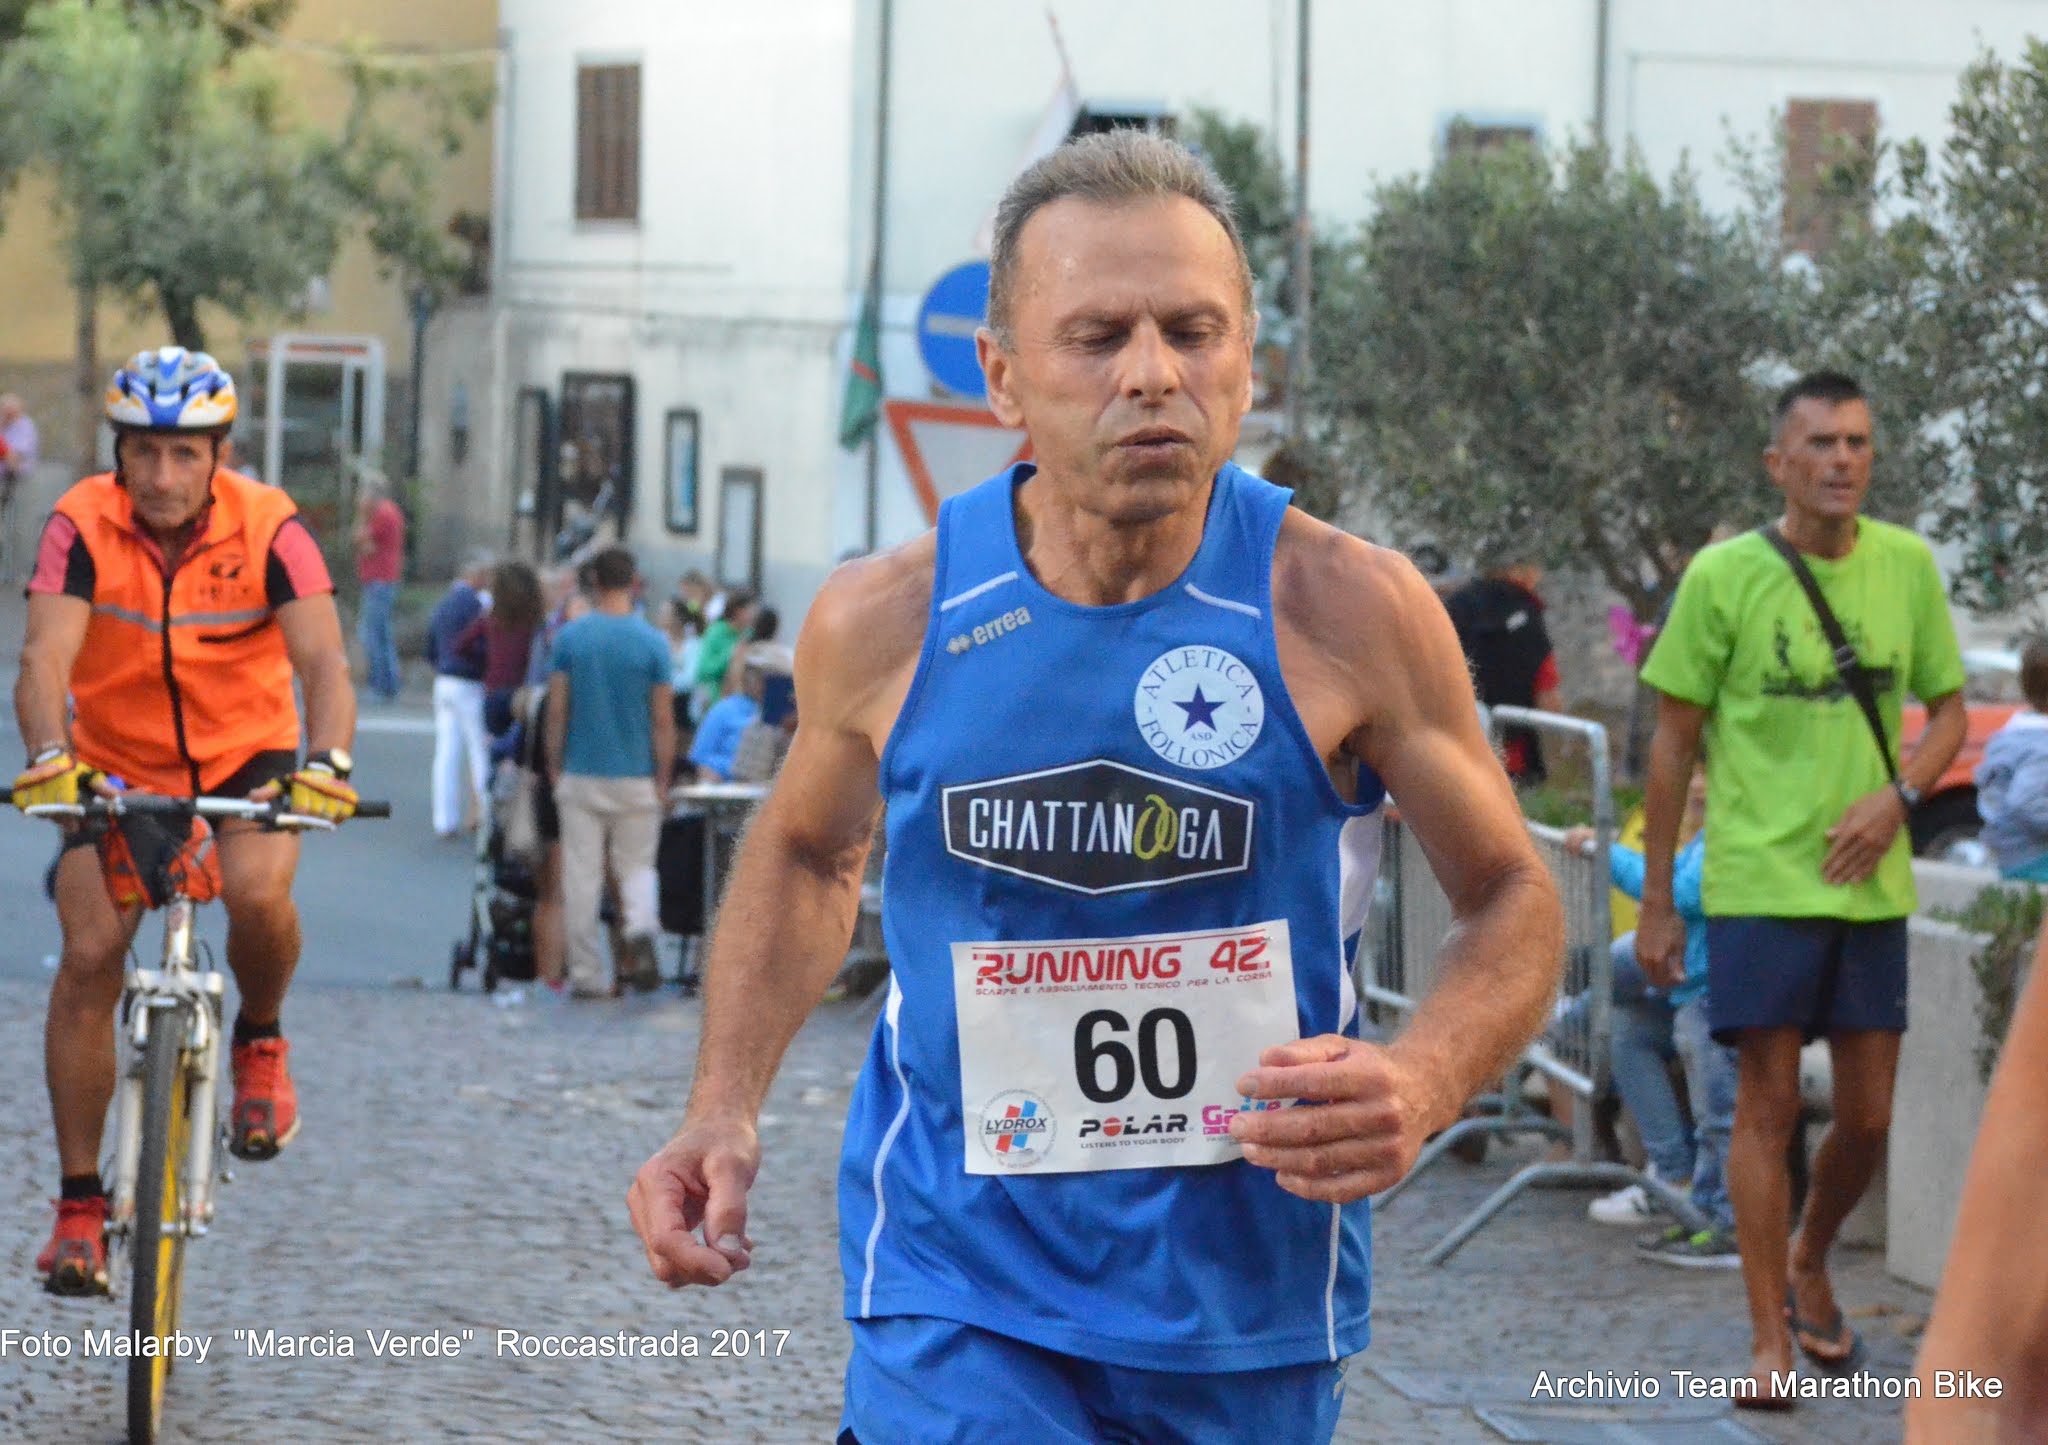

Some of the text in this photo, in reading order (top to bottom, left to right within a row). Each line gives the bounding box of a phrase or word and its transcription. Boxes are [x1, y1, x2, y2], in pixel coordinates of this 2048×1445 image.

[973, 606, 1031, 645] errea
[1143, 649, 1255, 699] ATLETICA
[1141, 720, 1258, 767] FOLLONICA
[1191, 732, 1212, 741] ASD
[968, 794, 1223, 860] CHATTANOOGA
[973, 936, 1270, 986] RUNNING 42
[1134, 980, 1181, 990] TECNICO
[1187, 978, 1209, 987] PER
[1215, 976, 1230, 985] LA
[1236, 971, 1272, 983] CORSA
[1074, 1007, 1198, 1103] 60
[986, 1117, 1047, 1131] LYDROX
[1079, 1113, 1189, 1138] POLAR
[1081, 1137, 1185, 1149] LISTENS TO YOUR BODY
